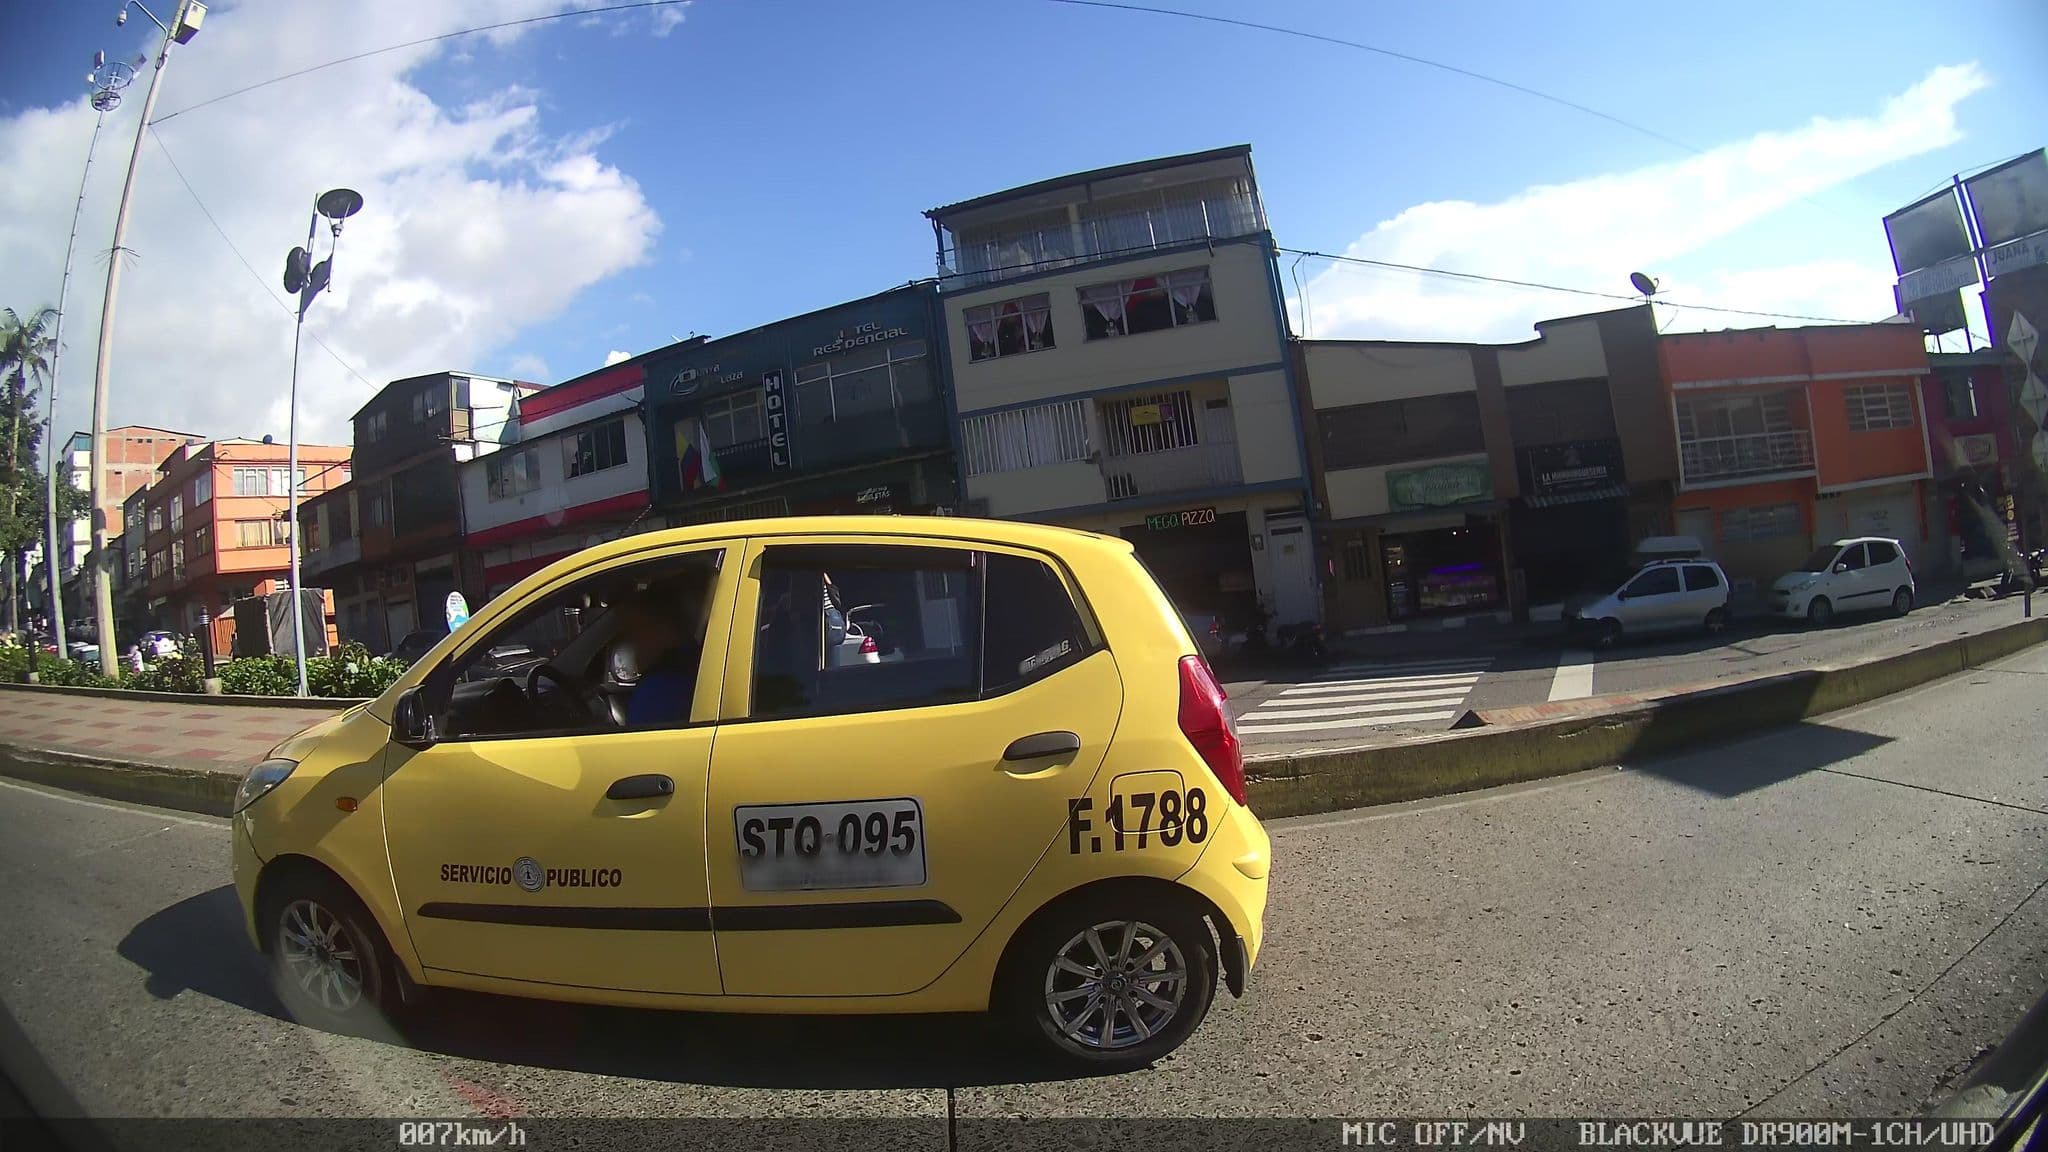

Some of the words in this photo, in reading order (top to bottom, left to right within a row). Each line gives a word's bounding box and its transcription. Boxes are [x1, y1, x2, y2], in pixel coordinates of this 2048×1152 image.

[813, 327, 908, 356] RESDENCIAL
[765, 376, 787, 466] HOTEL
[1144, 513, 1179, 530] MEGA
[1181, 508, 1216, 526] PIZZA
[742, 816, 823, 859] STQ
[838, 810, 916, 858] 095
[1068, 788, 1208, 854] F.1788
[440, 863, 512, 885] SERVICIO
[546, 868, 622, 888] PUBLICO
